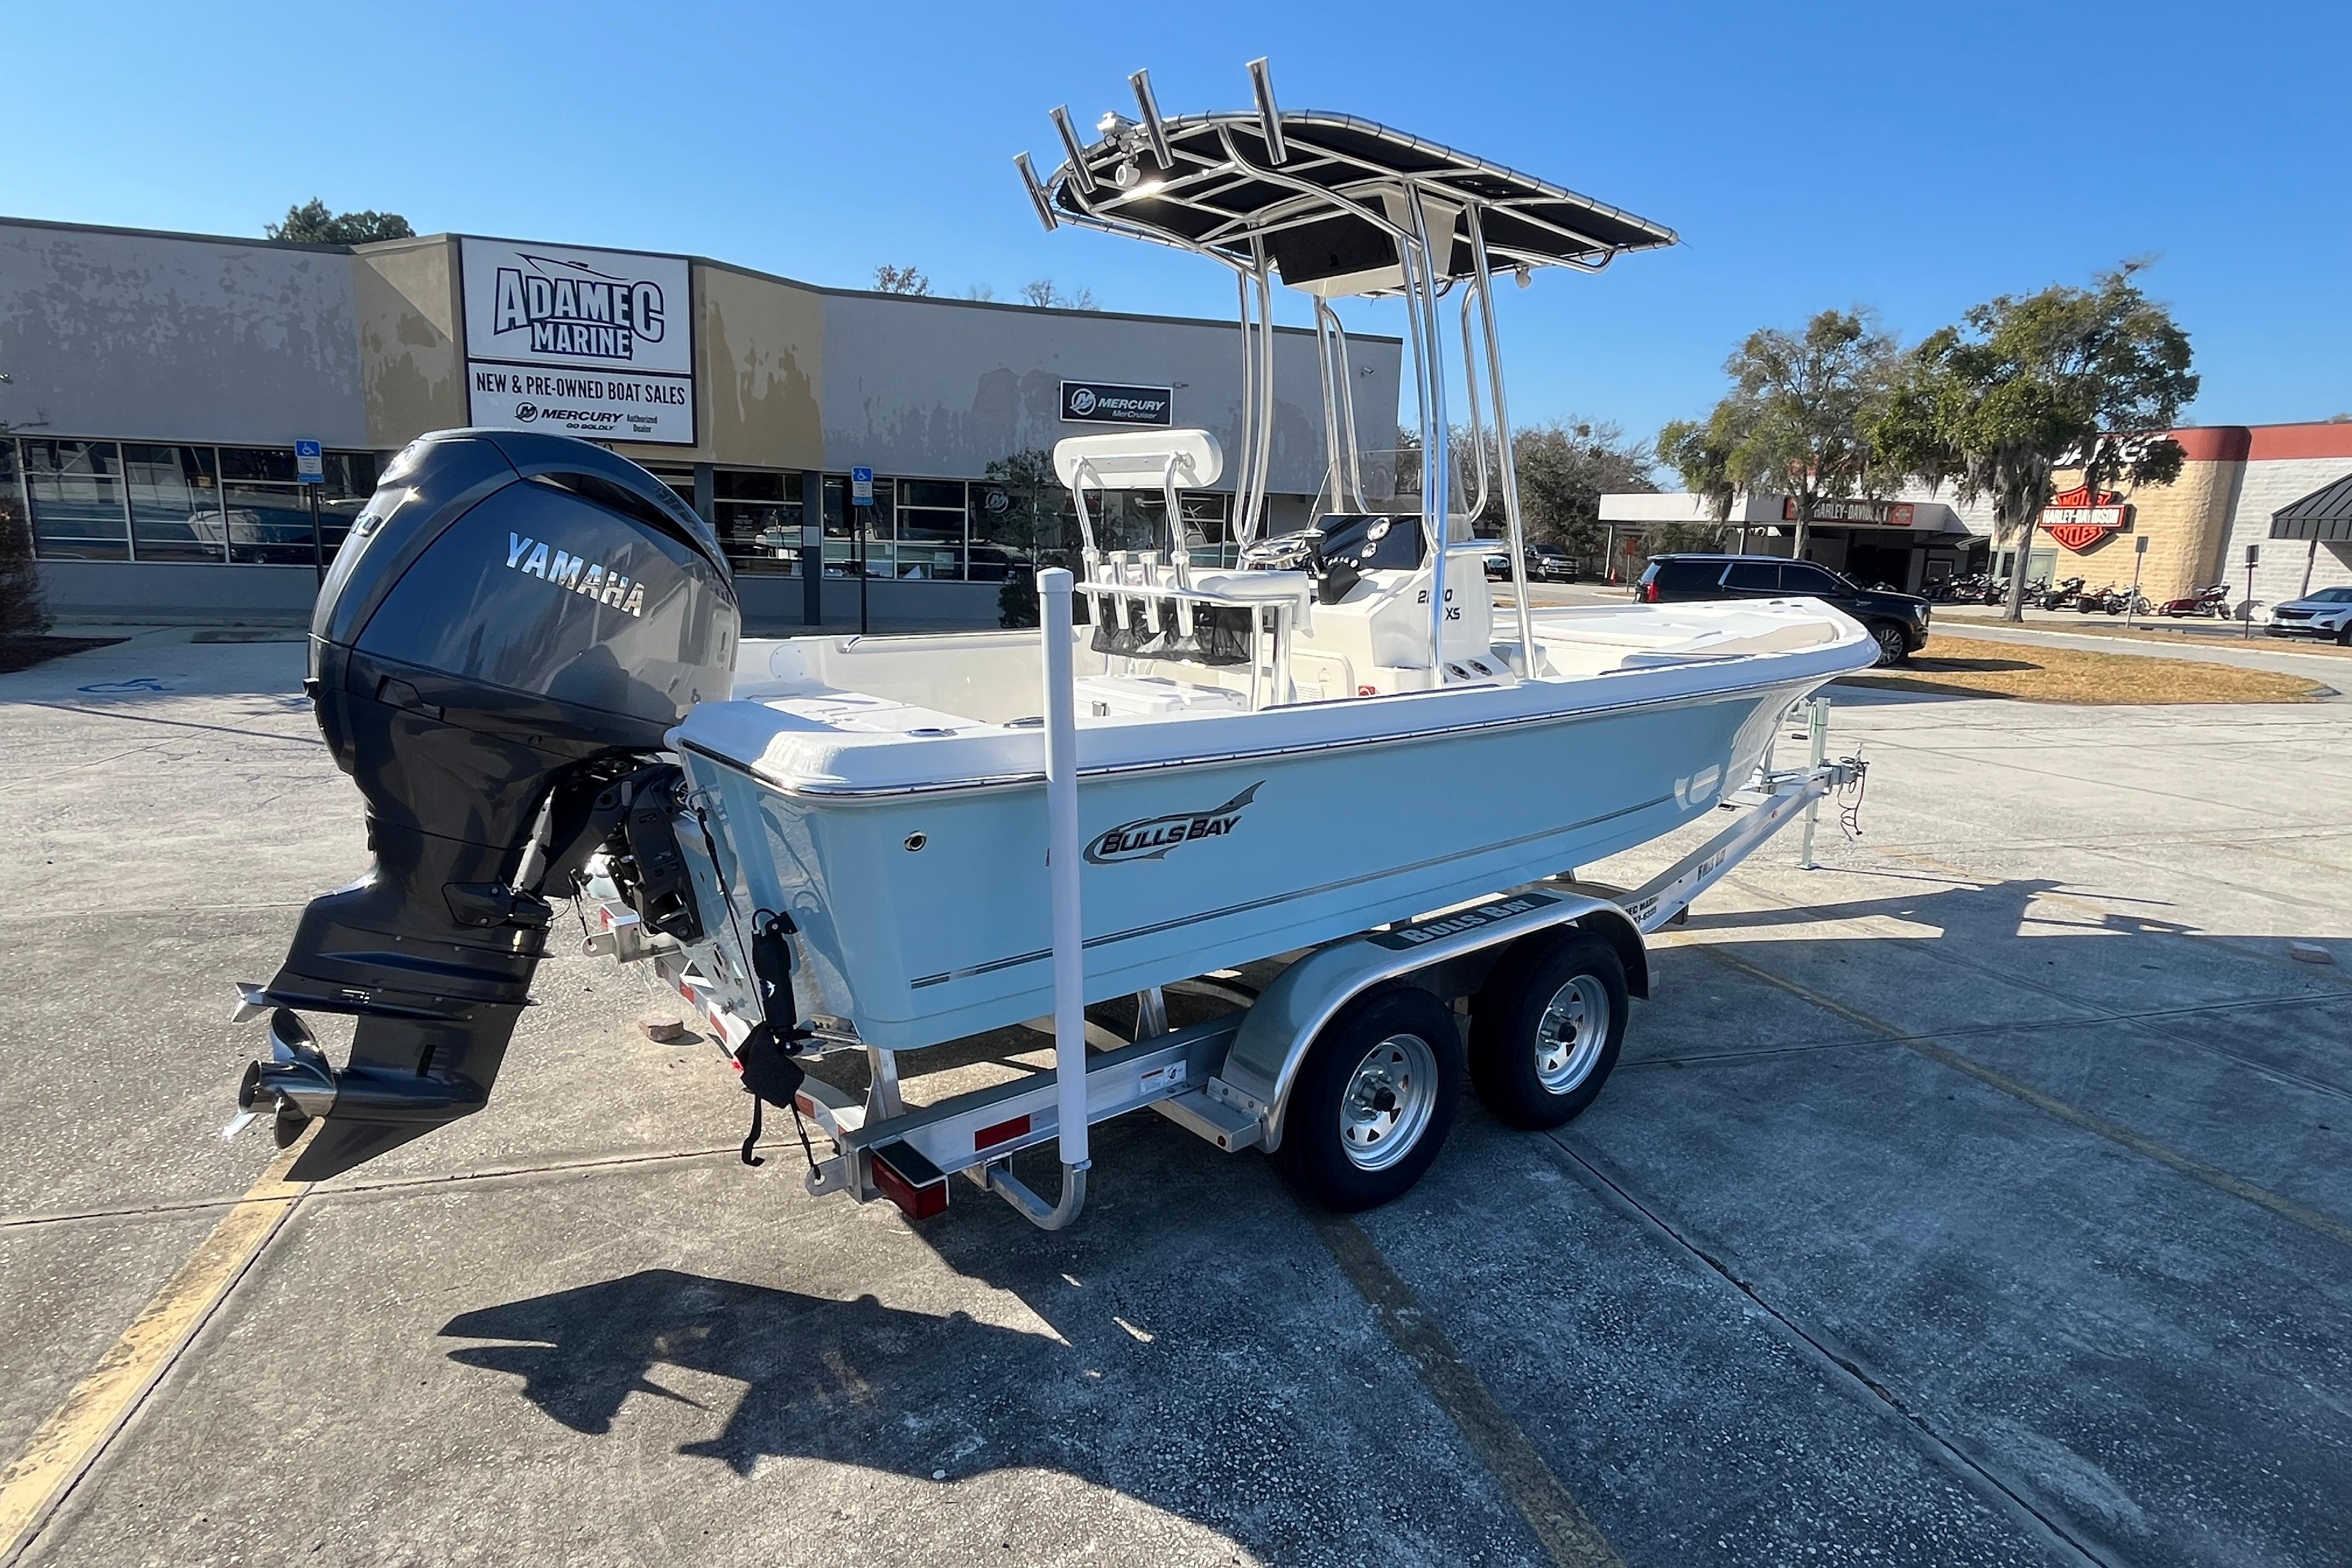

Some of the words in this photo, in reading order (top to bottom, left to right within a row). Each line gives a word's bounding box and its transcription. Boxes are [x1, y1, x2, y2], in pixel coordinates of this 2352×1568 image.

[494, 267, 664, 343] ADAMEC
[531, 321, 632, 359] MARINE
[476, 372, 506, 393] NEW
[512, 375, 522, 394] &
[527, 376, 603, 400] PRE-OWNED
[608, 382, 641, 402] BOAT
[645, 384, 685, 405] SALES
[541, 408, 624, 423] MERCURY
[1098, 398, 1166, 411] MERCURY
[1112, 410, 1157, 419] MerCruiser
[2042, 509, 2120, 524] HARLEY-DAVIDSON
[2056, 527, 2097, 544] CYCLES
[506, 532, 645, 618] YAMAHA
[1444, 607, 1460, 621] XS
[1100, 824, 1186, 855] BULLS
[1185, 816, 1242, 841] BAY
[1397, 915, 1487, 942] BULLS
[1478, 900, 1535, 918] BAY
